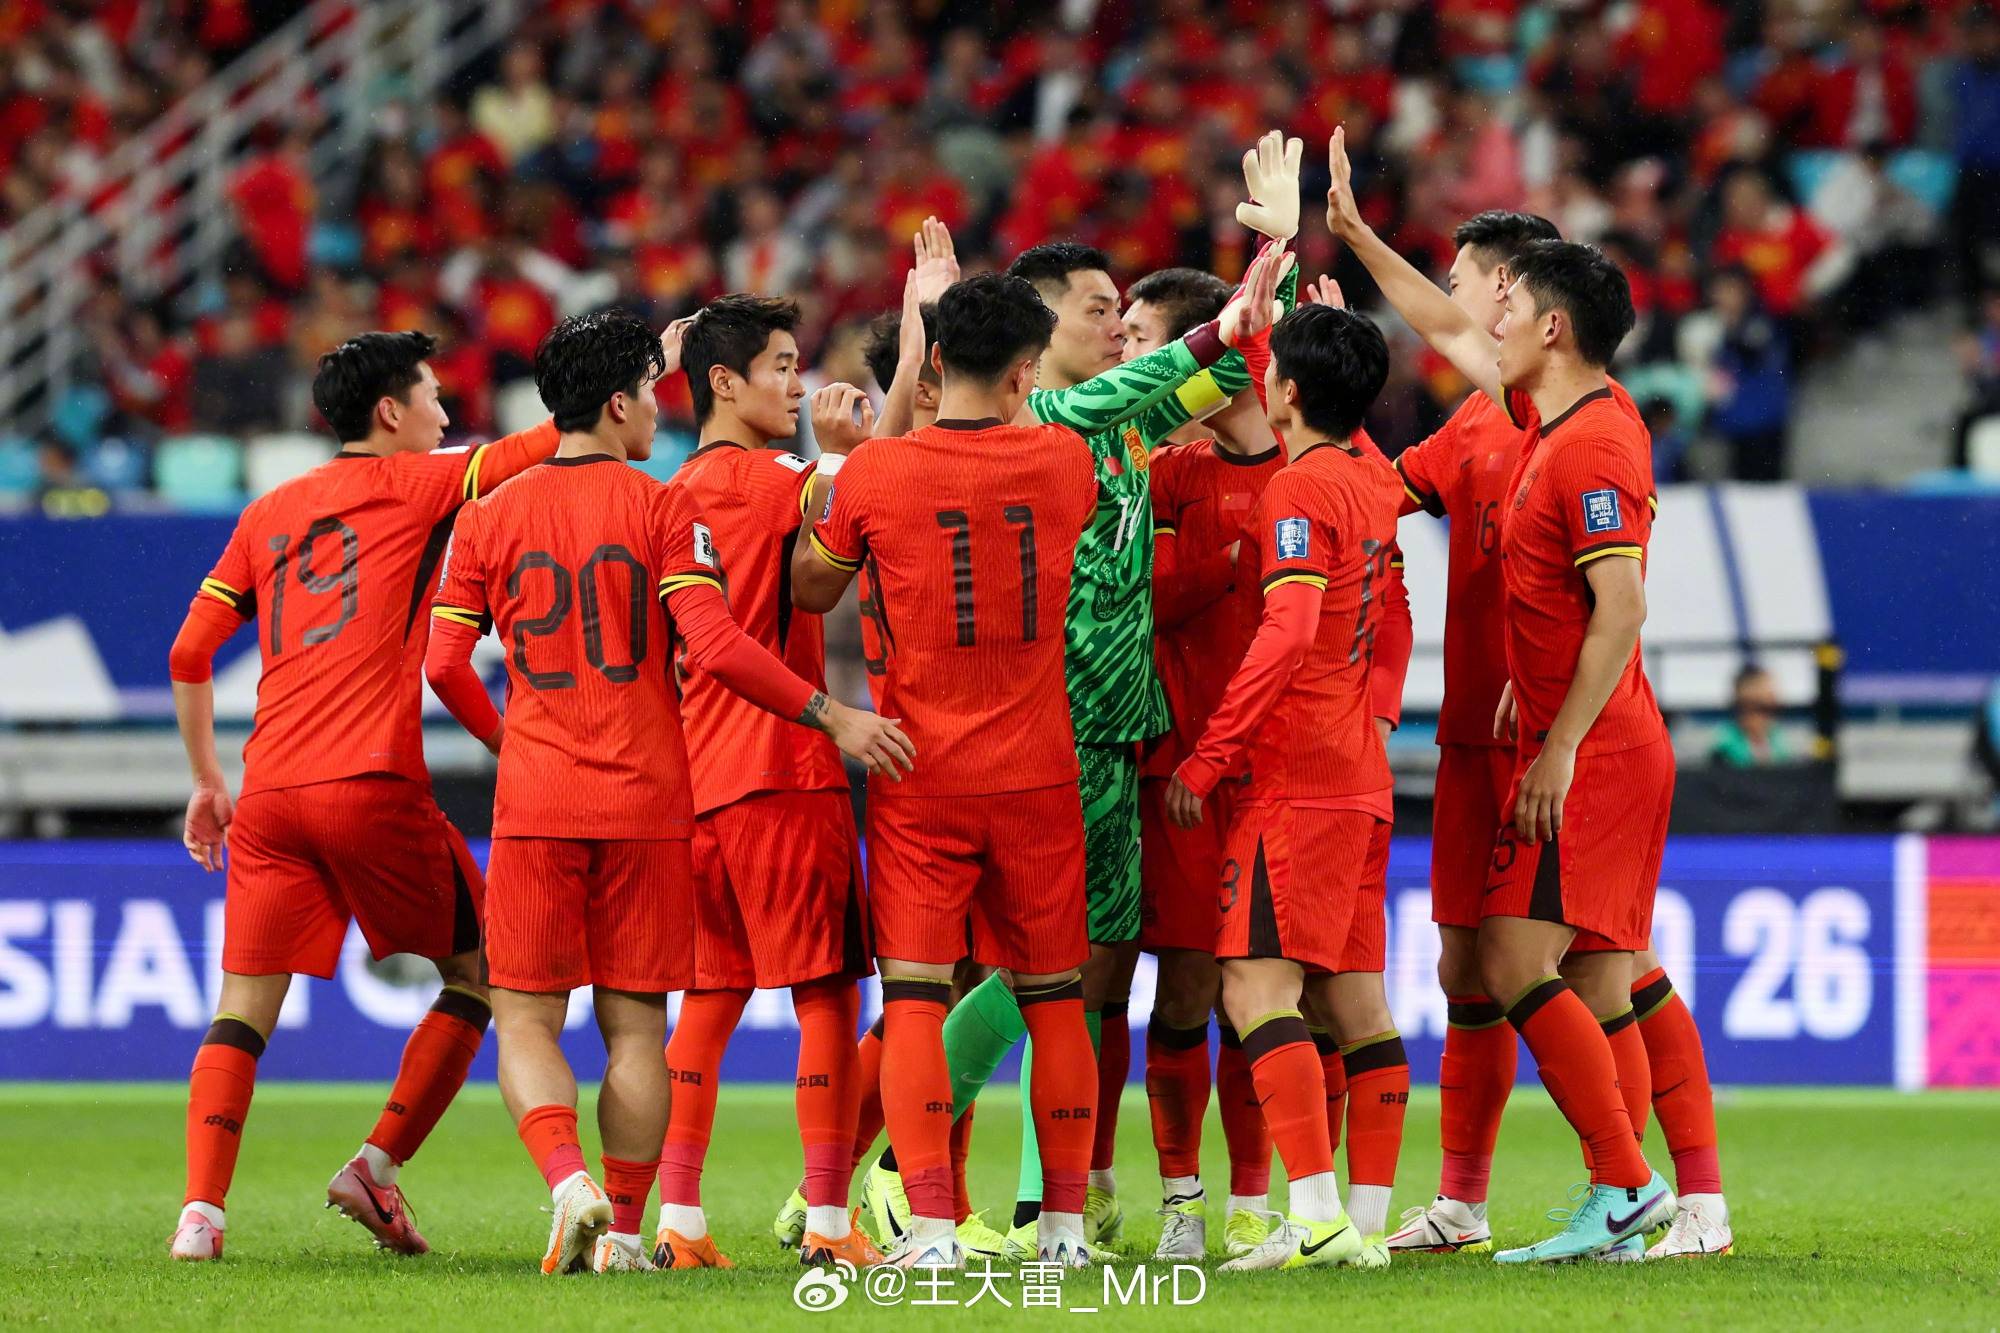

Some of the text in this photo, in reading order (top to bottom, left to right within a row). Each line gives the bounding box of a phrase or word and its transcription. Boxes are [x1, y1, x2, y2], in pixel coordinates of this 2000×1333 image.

[267, 516, 358, 656] 19
[936, 505, 1037, 646] 11
[1472, 501, 1498, 556] 16
[509, 545, 648, 689] 20
[1724, 887, 1873, 1040] 26
[204, 1114, 240, 1135] 中国
[1051, 1108, 1091, 1120] 中国
